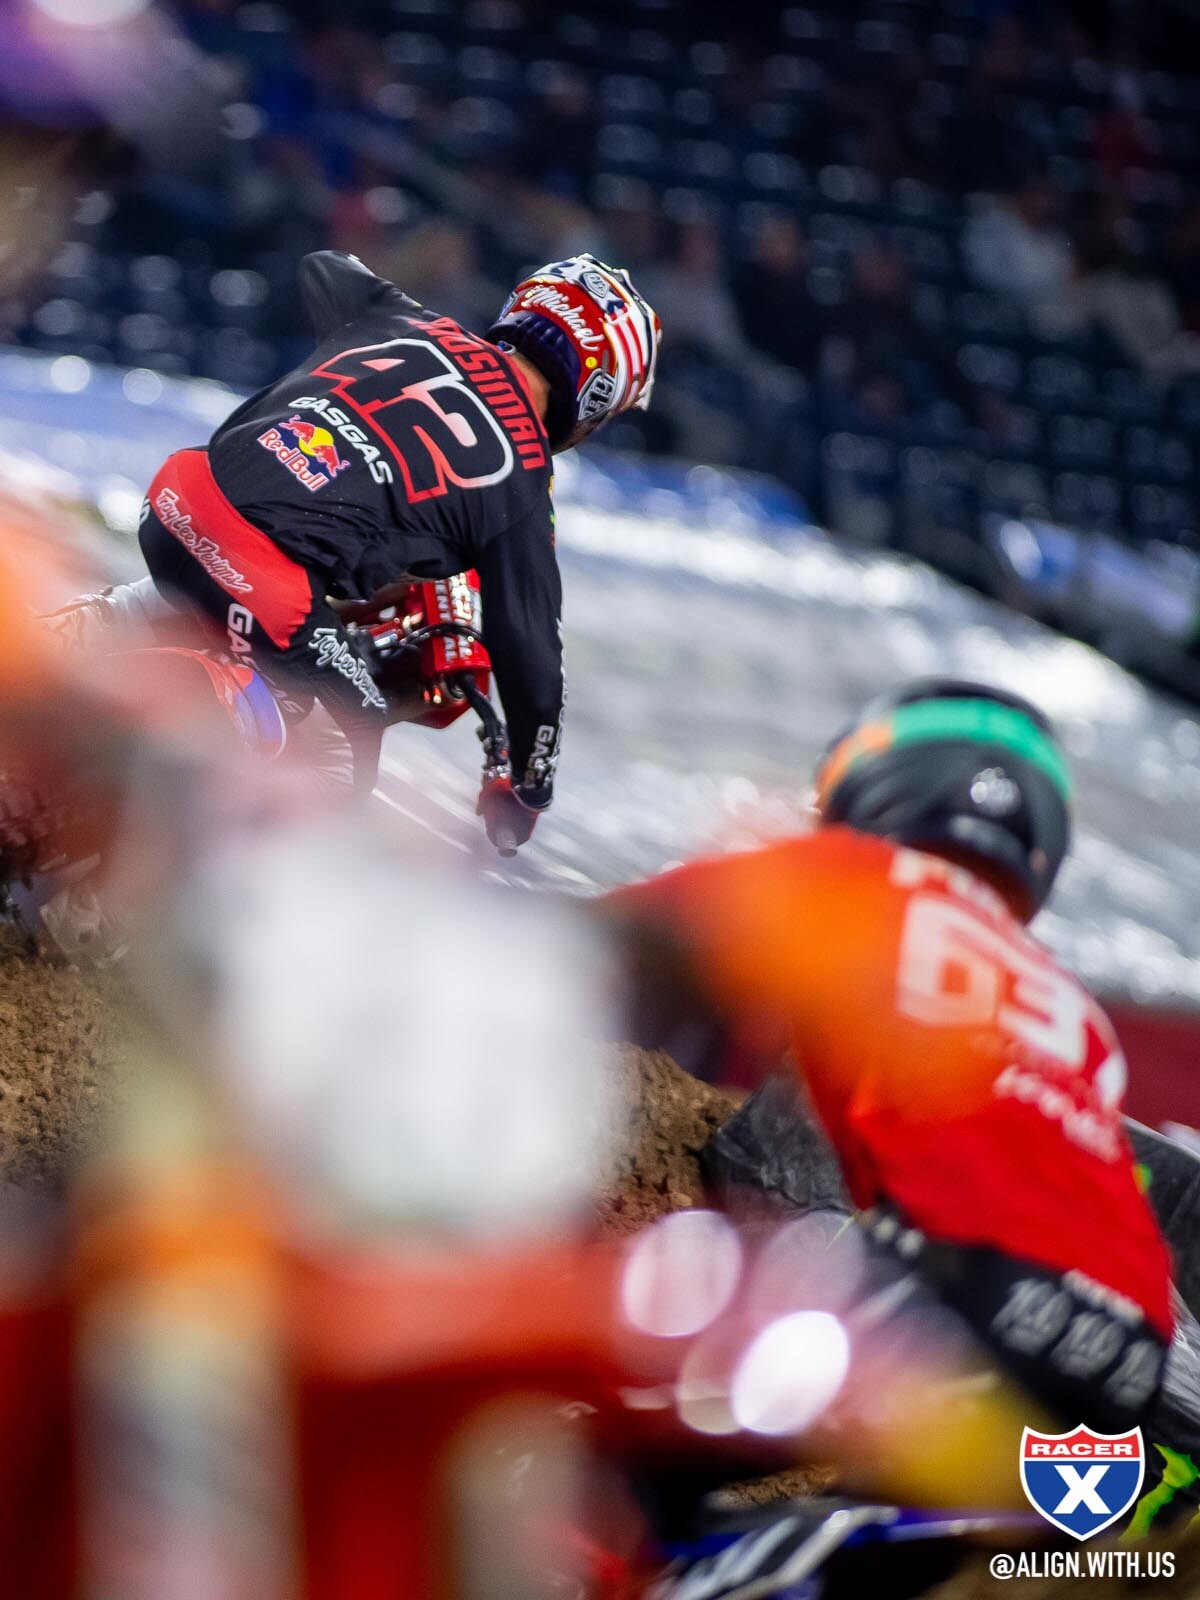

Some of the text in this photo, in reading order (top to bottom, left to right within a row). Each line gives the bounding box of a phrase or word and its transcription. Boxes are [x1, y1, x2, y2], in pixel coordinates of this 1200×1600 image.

[521, 285, 604, 351] Michael
[288, 397, 393, 484] GASGAS
[309, 338, 514, 504] 42
[435, 579, 459, 663] ENTAL
